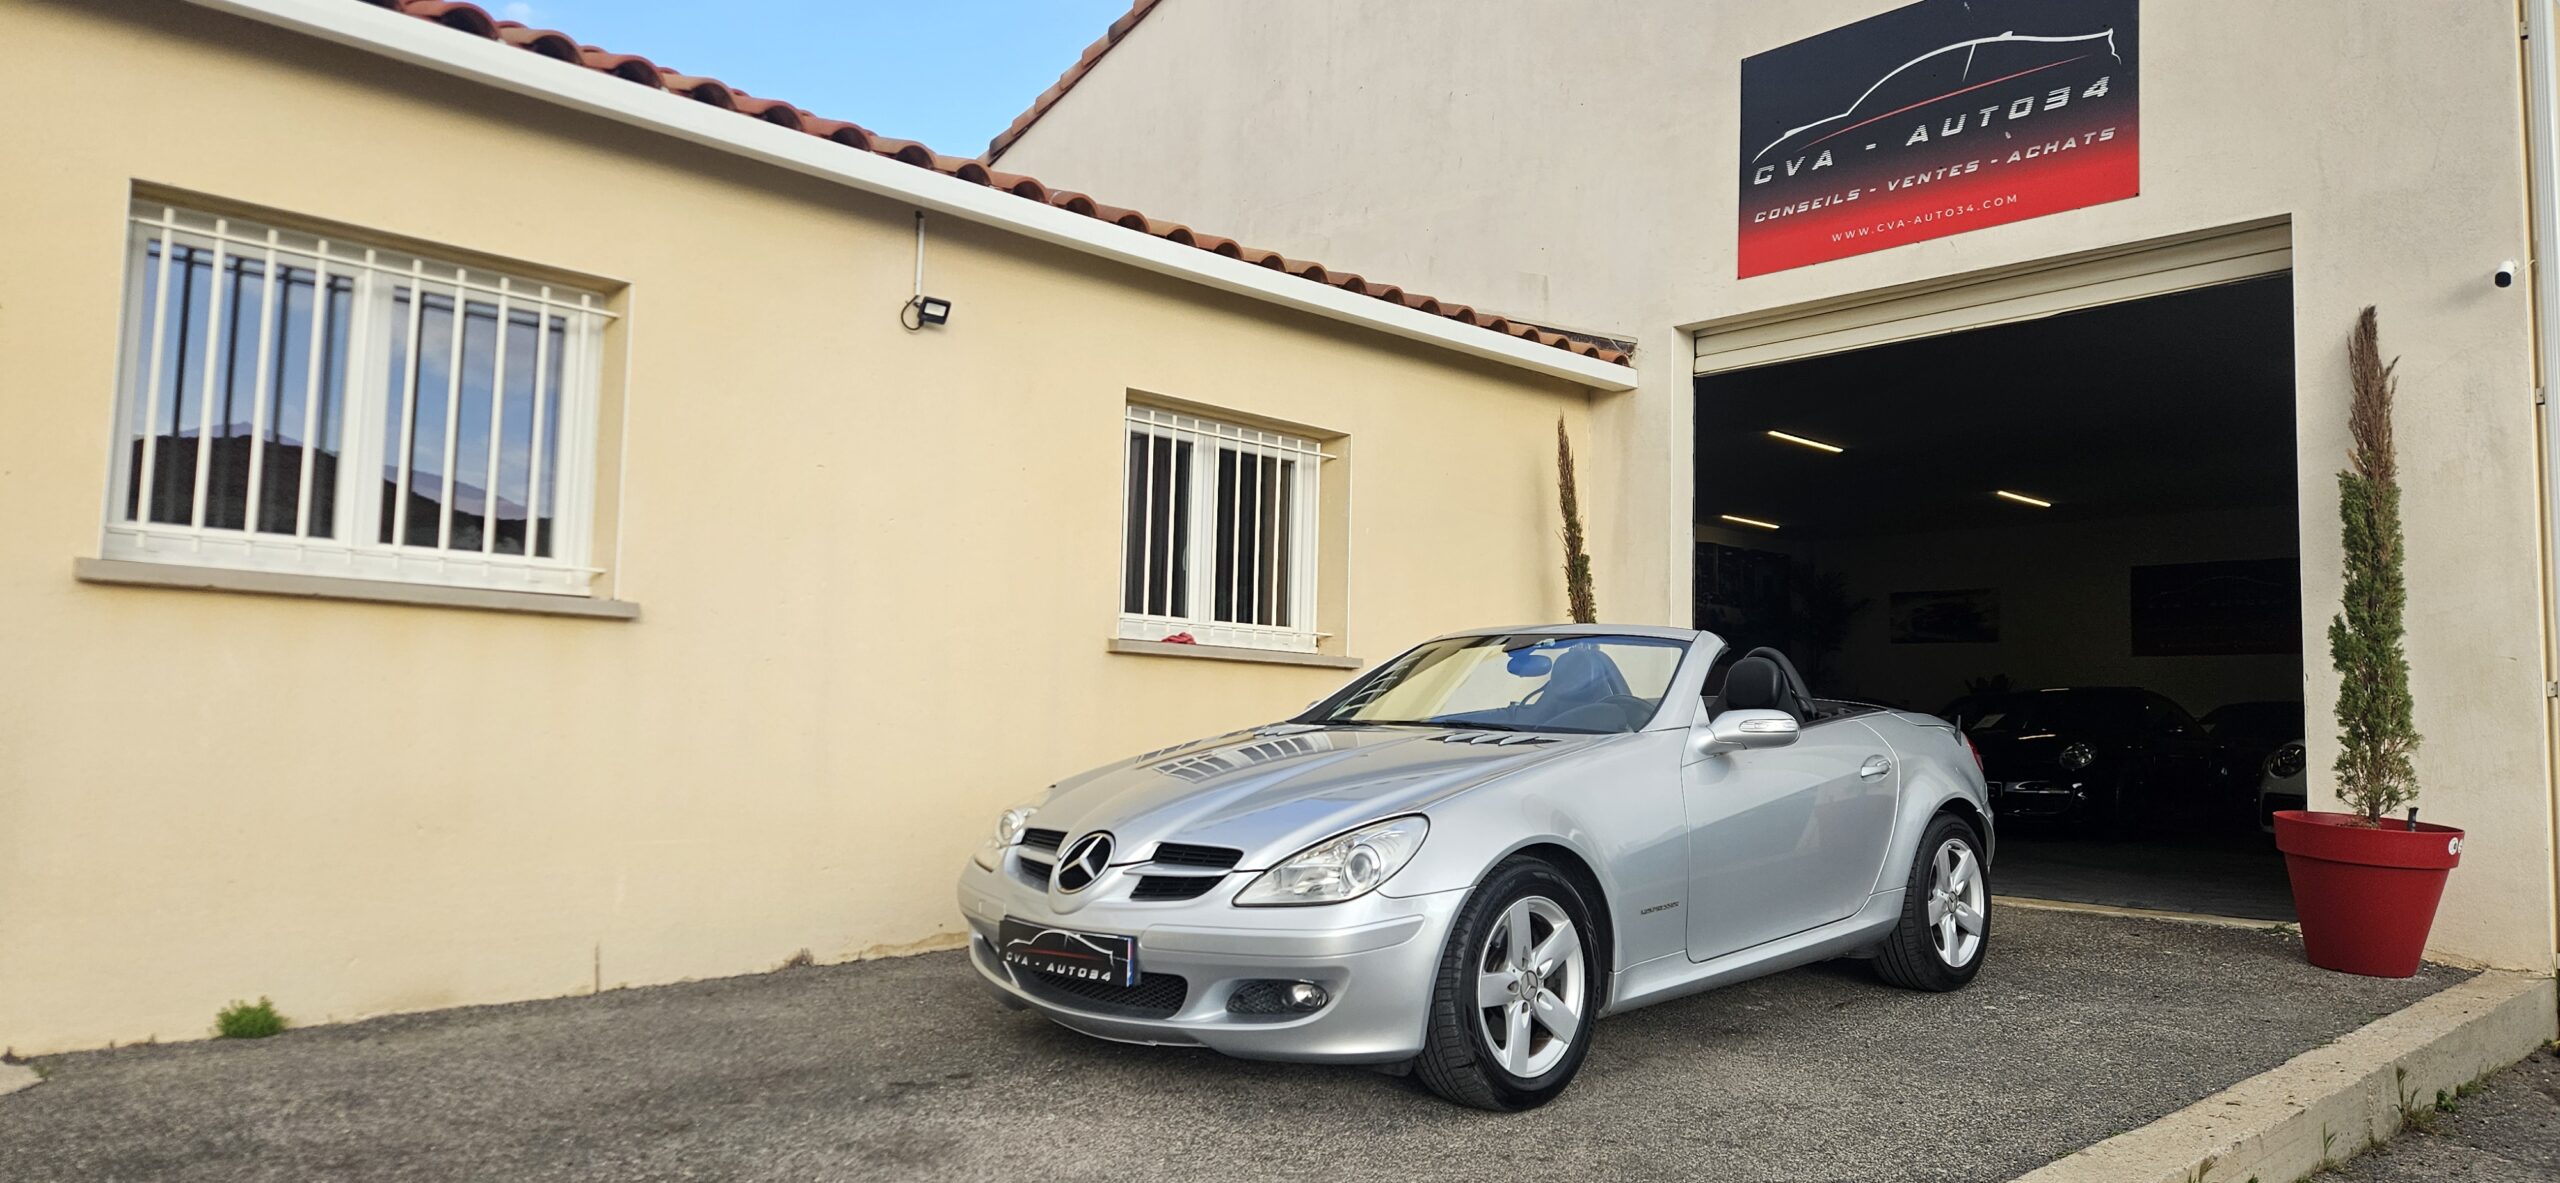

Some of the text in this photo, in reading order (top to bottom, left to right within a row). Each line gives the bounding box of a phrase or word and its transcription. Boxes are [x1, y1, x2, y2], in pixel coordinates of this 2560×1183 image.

[1754, 149, 1833, 185] CVA
[1906, 76, 2110, 147] AUTO34
[1754, 188, 1861, 223] CONSEILS
[1887, 160, 1980, 192] VENTES
[2007, 127, 2116, 164] ACHATS
[1832, 194, 2017, 242] WWW.CVA-AUTO34.COM
[1006, 952, 1028, 966] CVA
[1046, 962, 1112, 982] AUTO34
